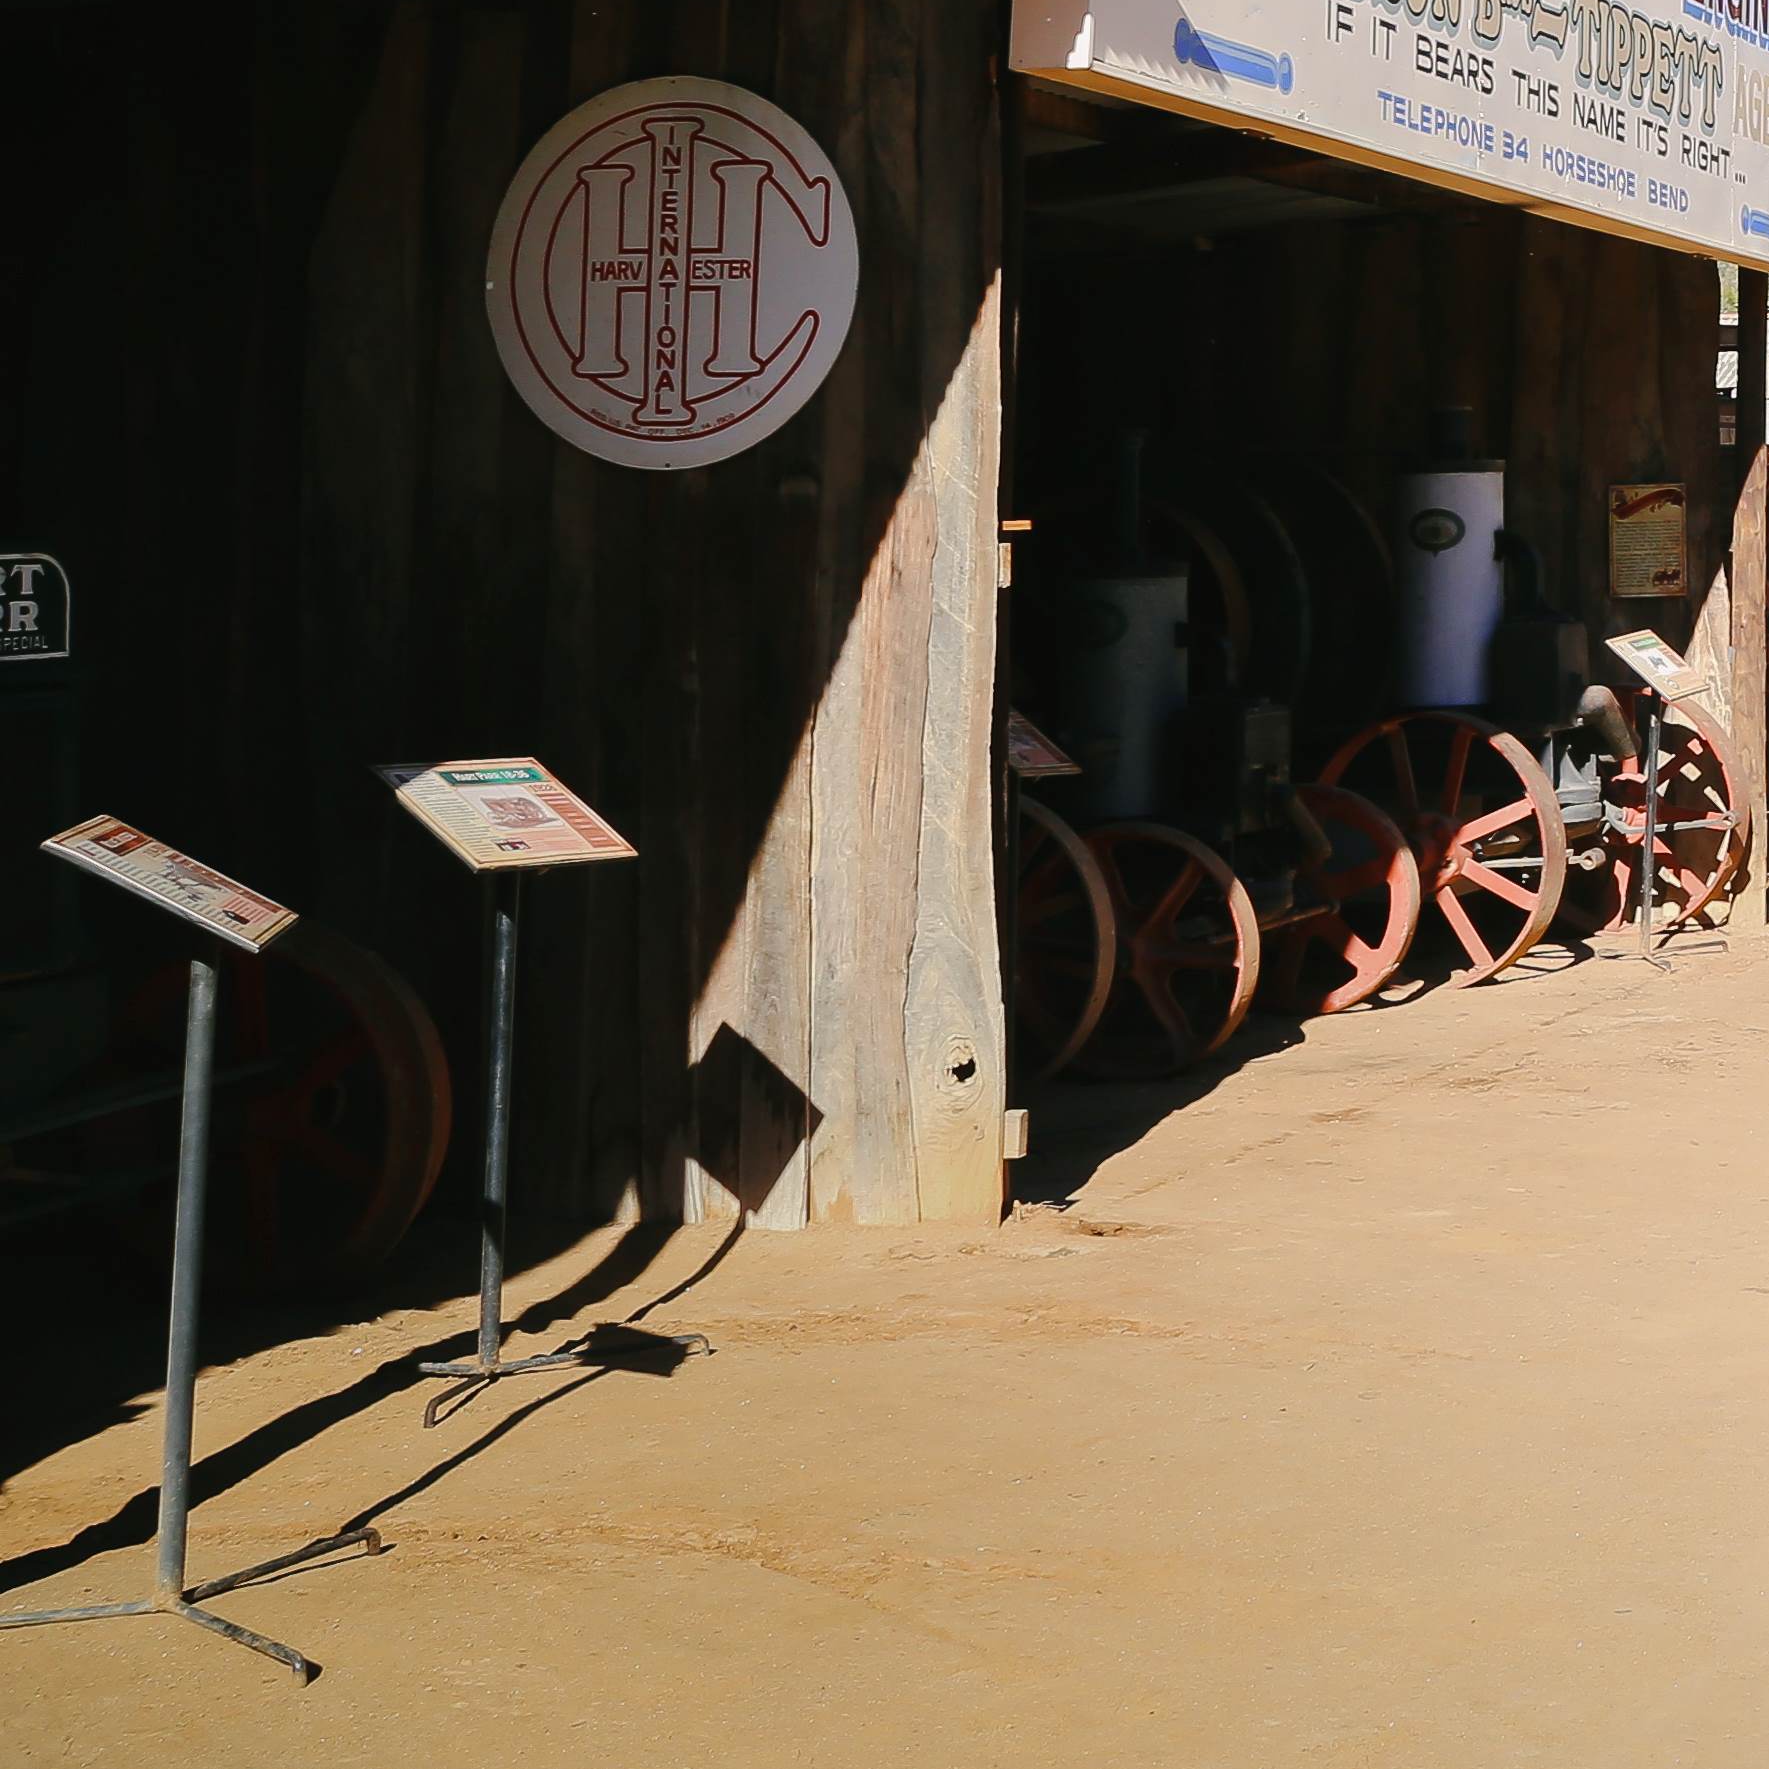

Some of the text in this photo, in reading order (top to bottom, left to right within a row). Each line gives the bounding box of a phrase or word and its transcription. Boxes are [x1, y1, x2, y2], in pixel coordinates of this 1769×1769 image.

[1372, 16, 1398, 61] IT
[1415, 33, 1495, 95] BEARS
[1511, 70, 1560, 118] THIS
[1573, 92, 1626, 143] NAME
[1636, 116, 1668, 157] IT'S
[1377, 89, 1690, 213] TELEPHONE 34 HORSESHOE BEND
[653, 124, 683, 415] INTERNATIONAL
